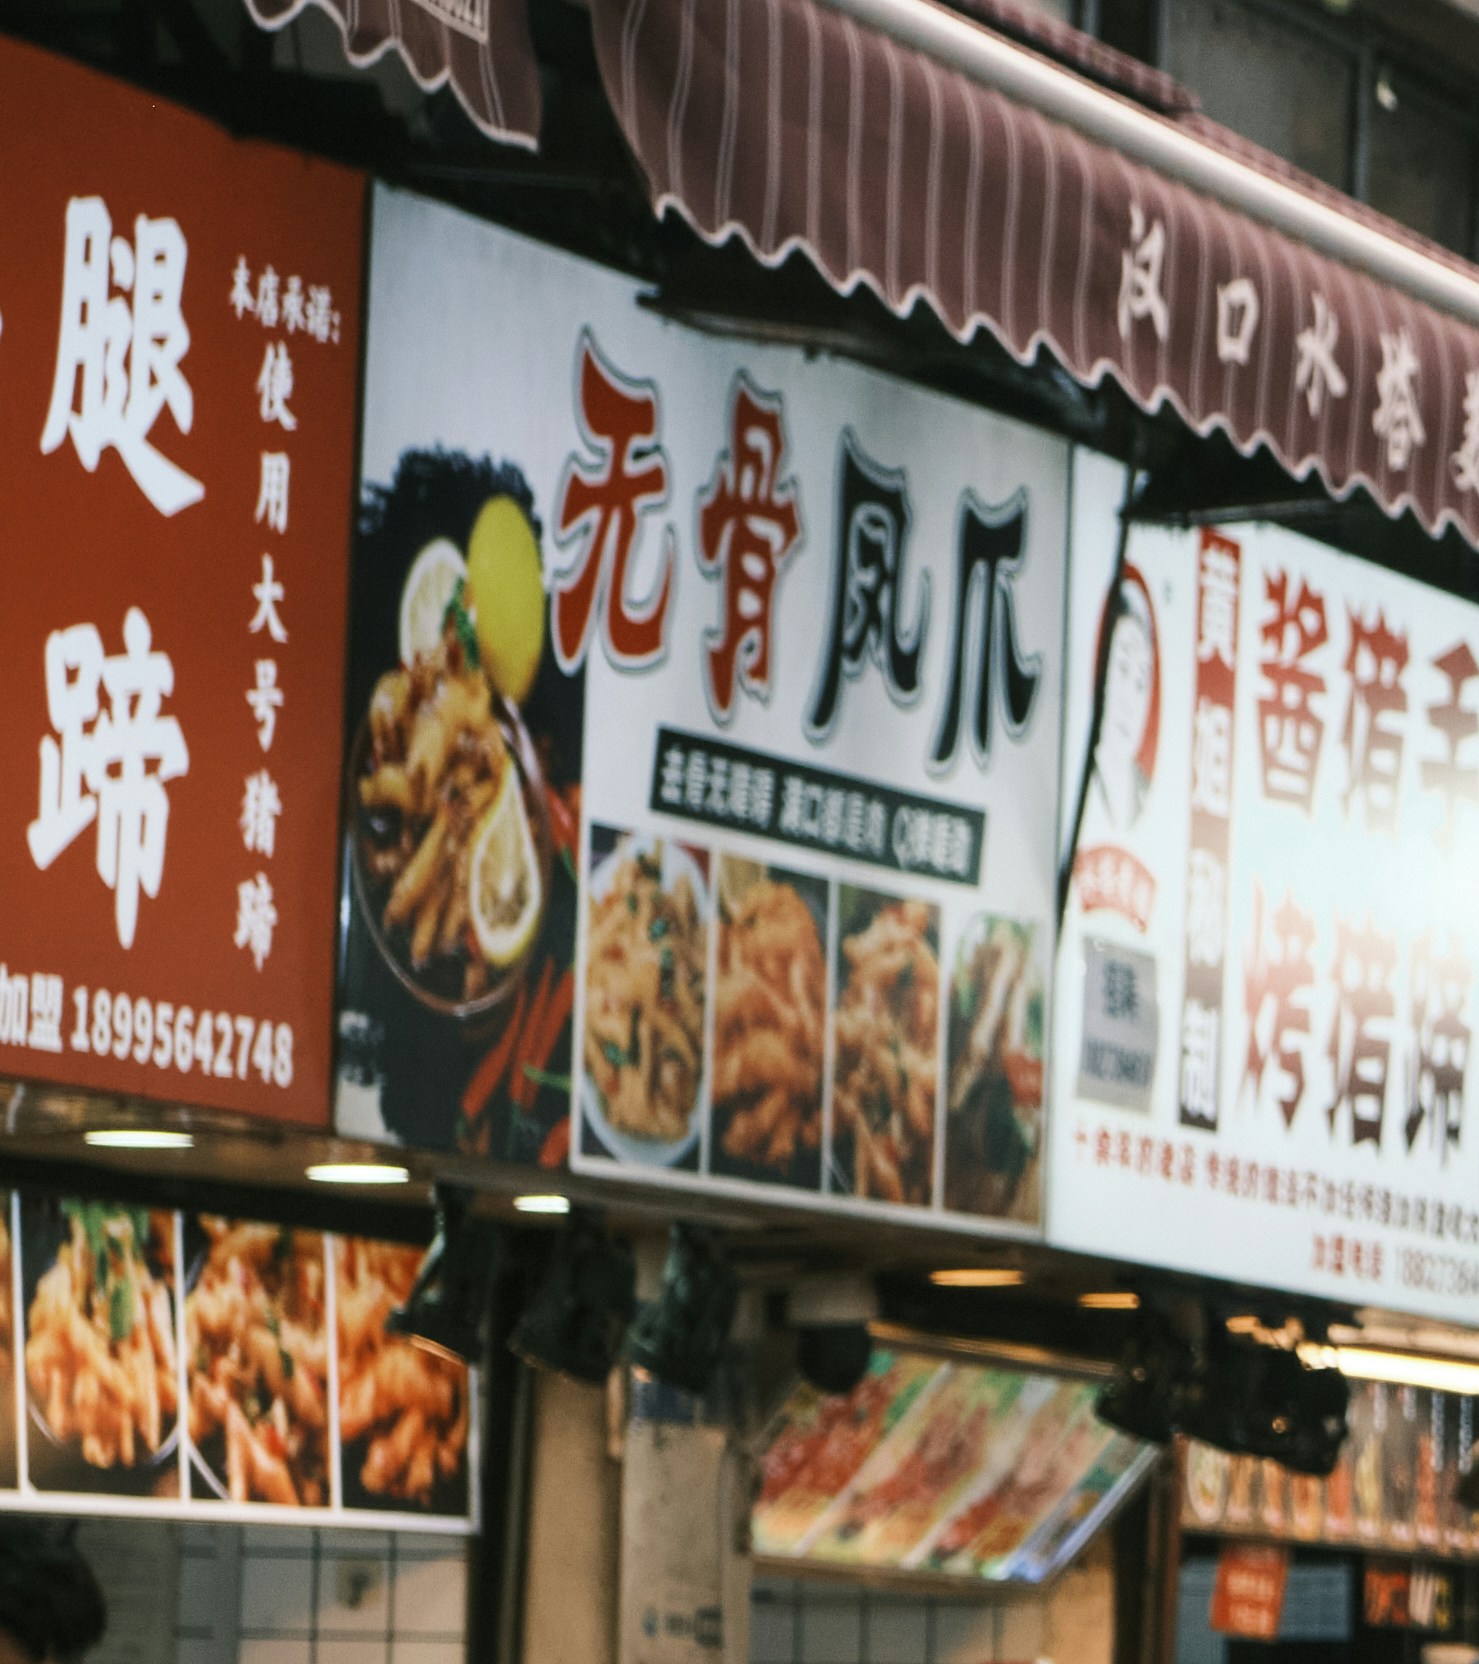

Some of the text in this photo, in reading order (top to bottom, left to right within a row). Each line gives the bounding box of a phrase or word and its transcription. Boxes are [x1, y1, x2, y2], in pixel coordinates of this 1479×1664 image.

[40, 196, 205, 518] 腿
[26, 606, 190, 950] 蹄
[71, 985, 294, 1090] 18995642748
